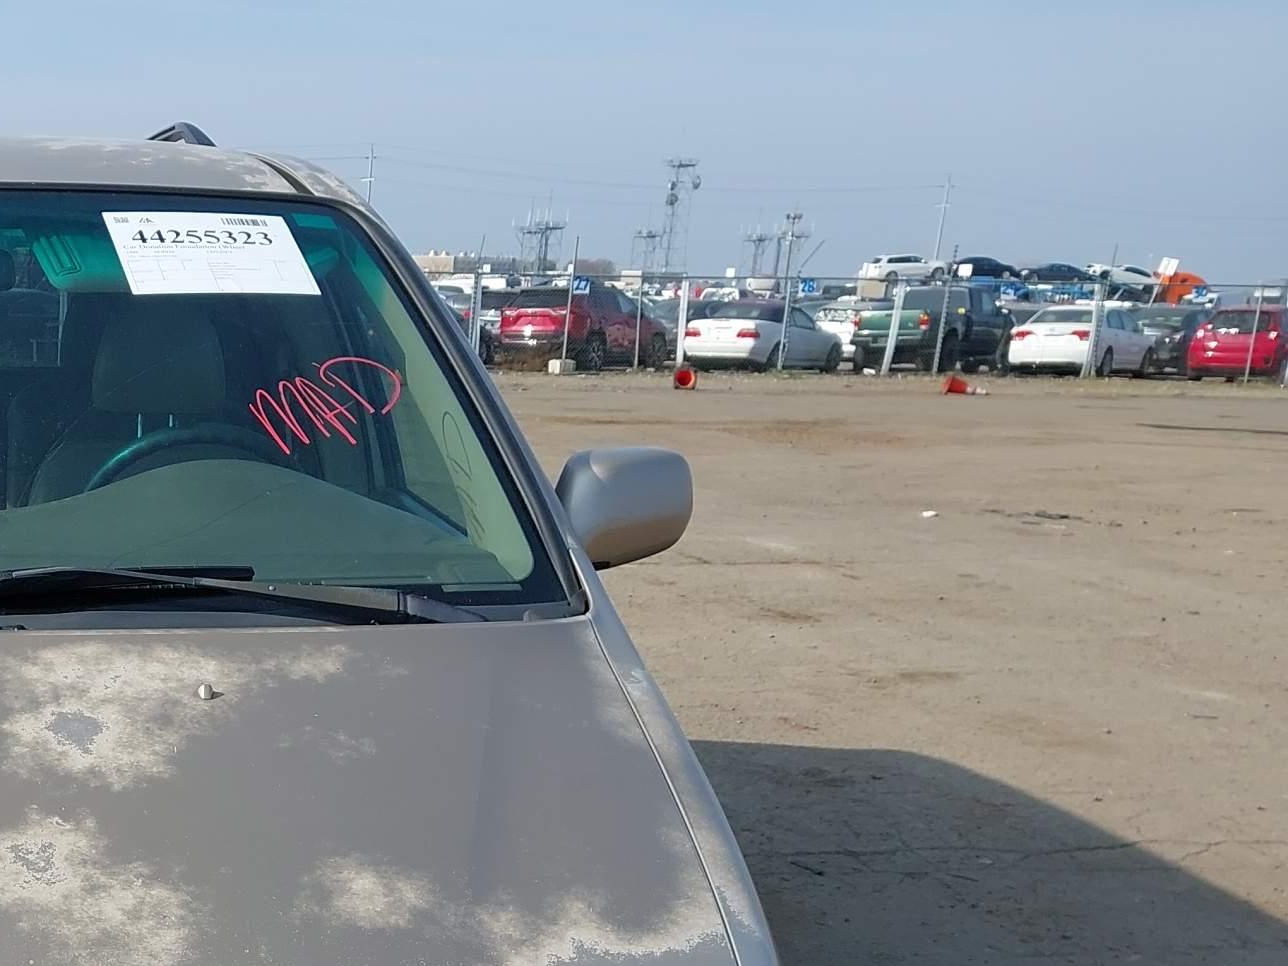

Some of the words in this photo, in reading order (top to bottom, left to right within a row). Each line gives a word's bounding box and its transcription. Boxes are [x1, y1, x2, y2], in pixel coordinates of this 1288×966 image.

[132, 230, 273, 246] 44255323
[574, 276, 589, 291] 27
[801, 279, 815, 293] 28
